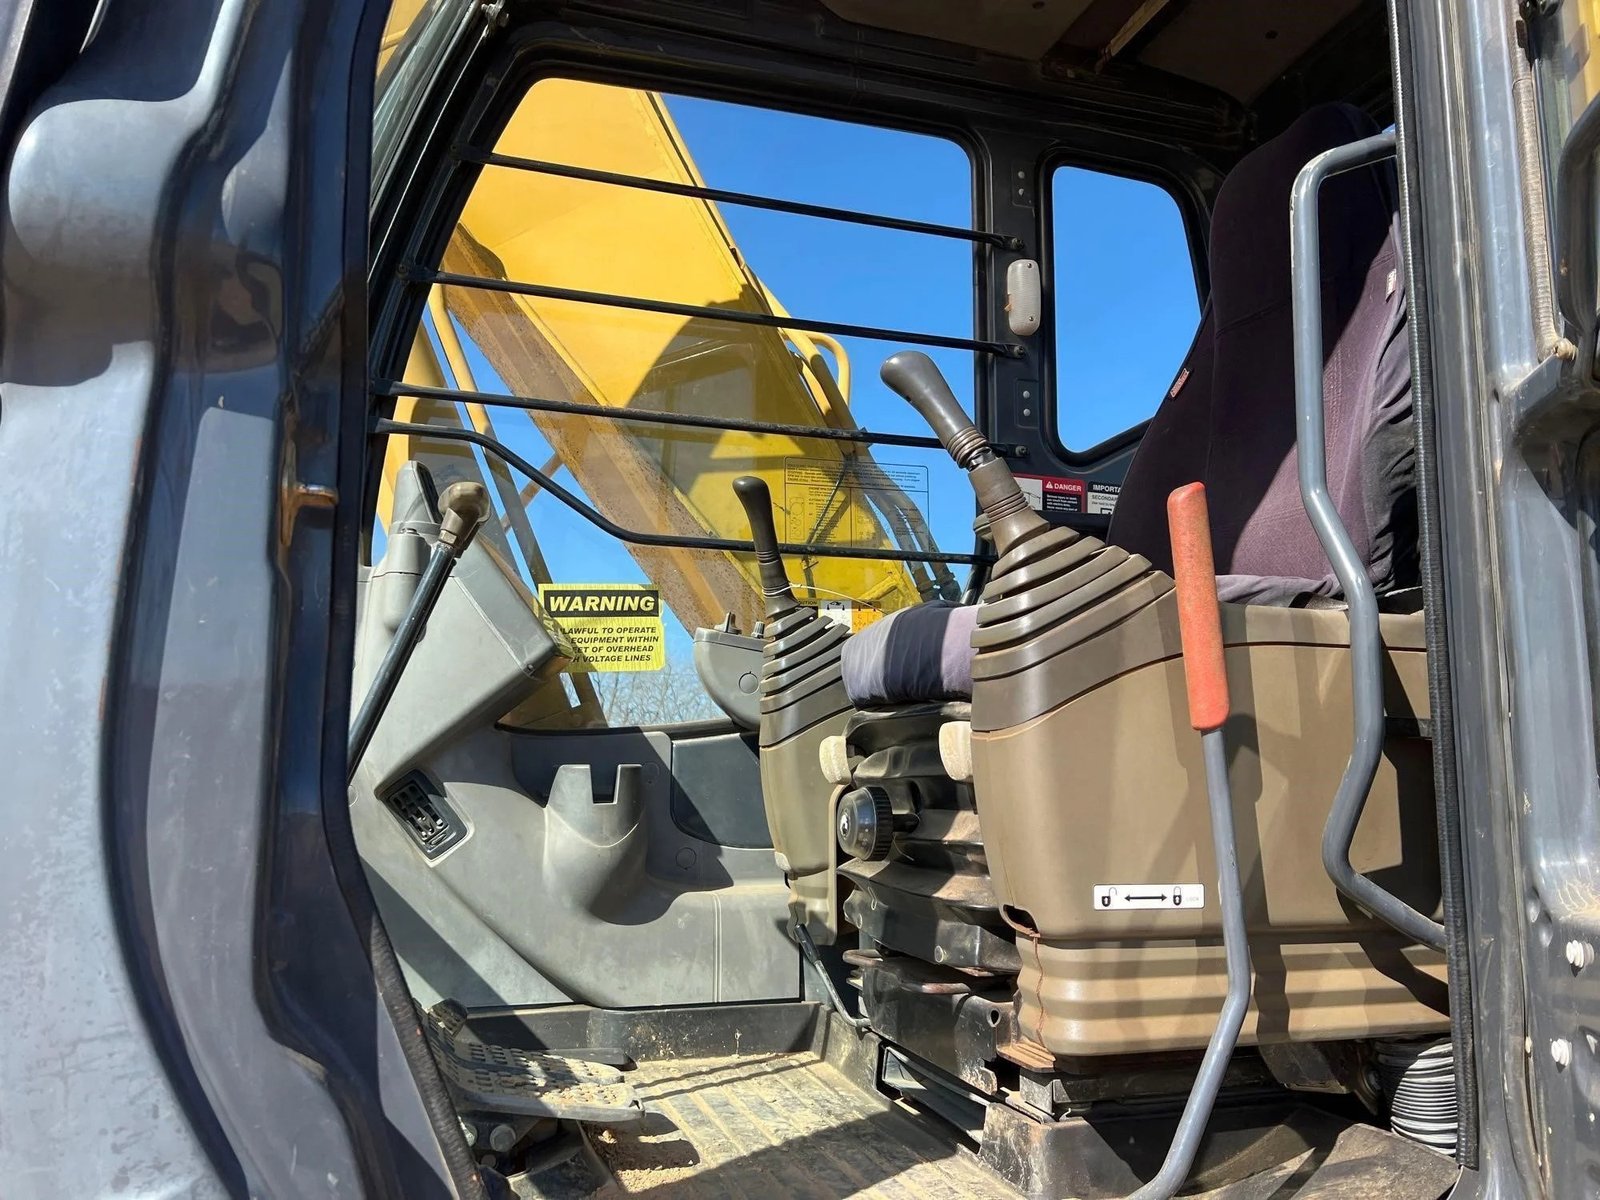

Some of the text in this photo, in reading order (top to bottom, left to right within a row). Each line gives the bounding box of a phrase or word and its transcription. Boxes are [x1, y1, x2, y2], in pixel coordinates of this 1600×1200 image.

[1054, 483, 1082, 491] DANGER
[549, 596, 655, 612] WARNING
[571, 636, 625, 644] EQUIPMENT
[606, 645, 654, 653] OVERHEAD
[583, 655, 623, 663] VOLTAGE
[625, 654, 651, 662] LINES
